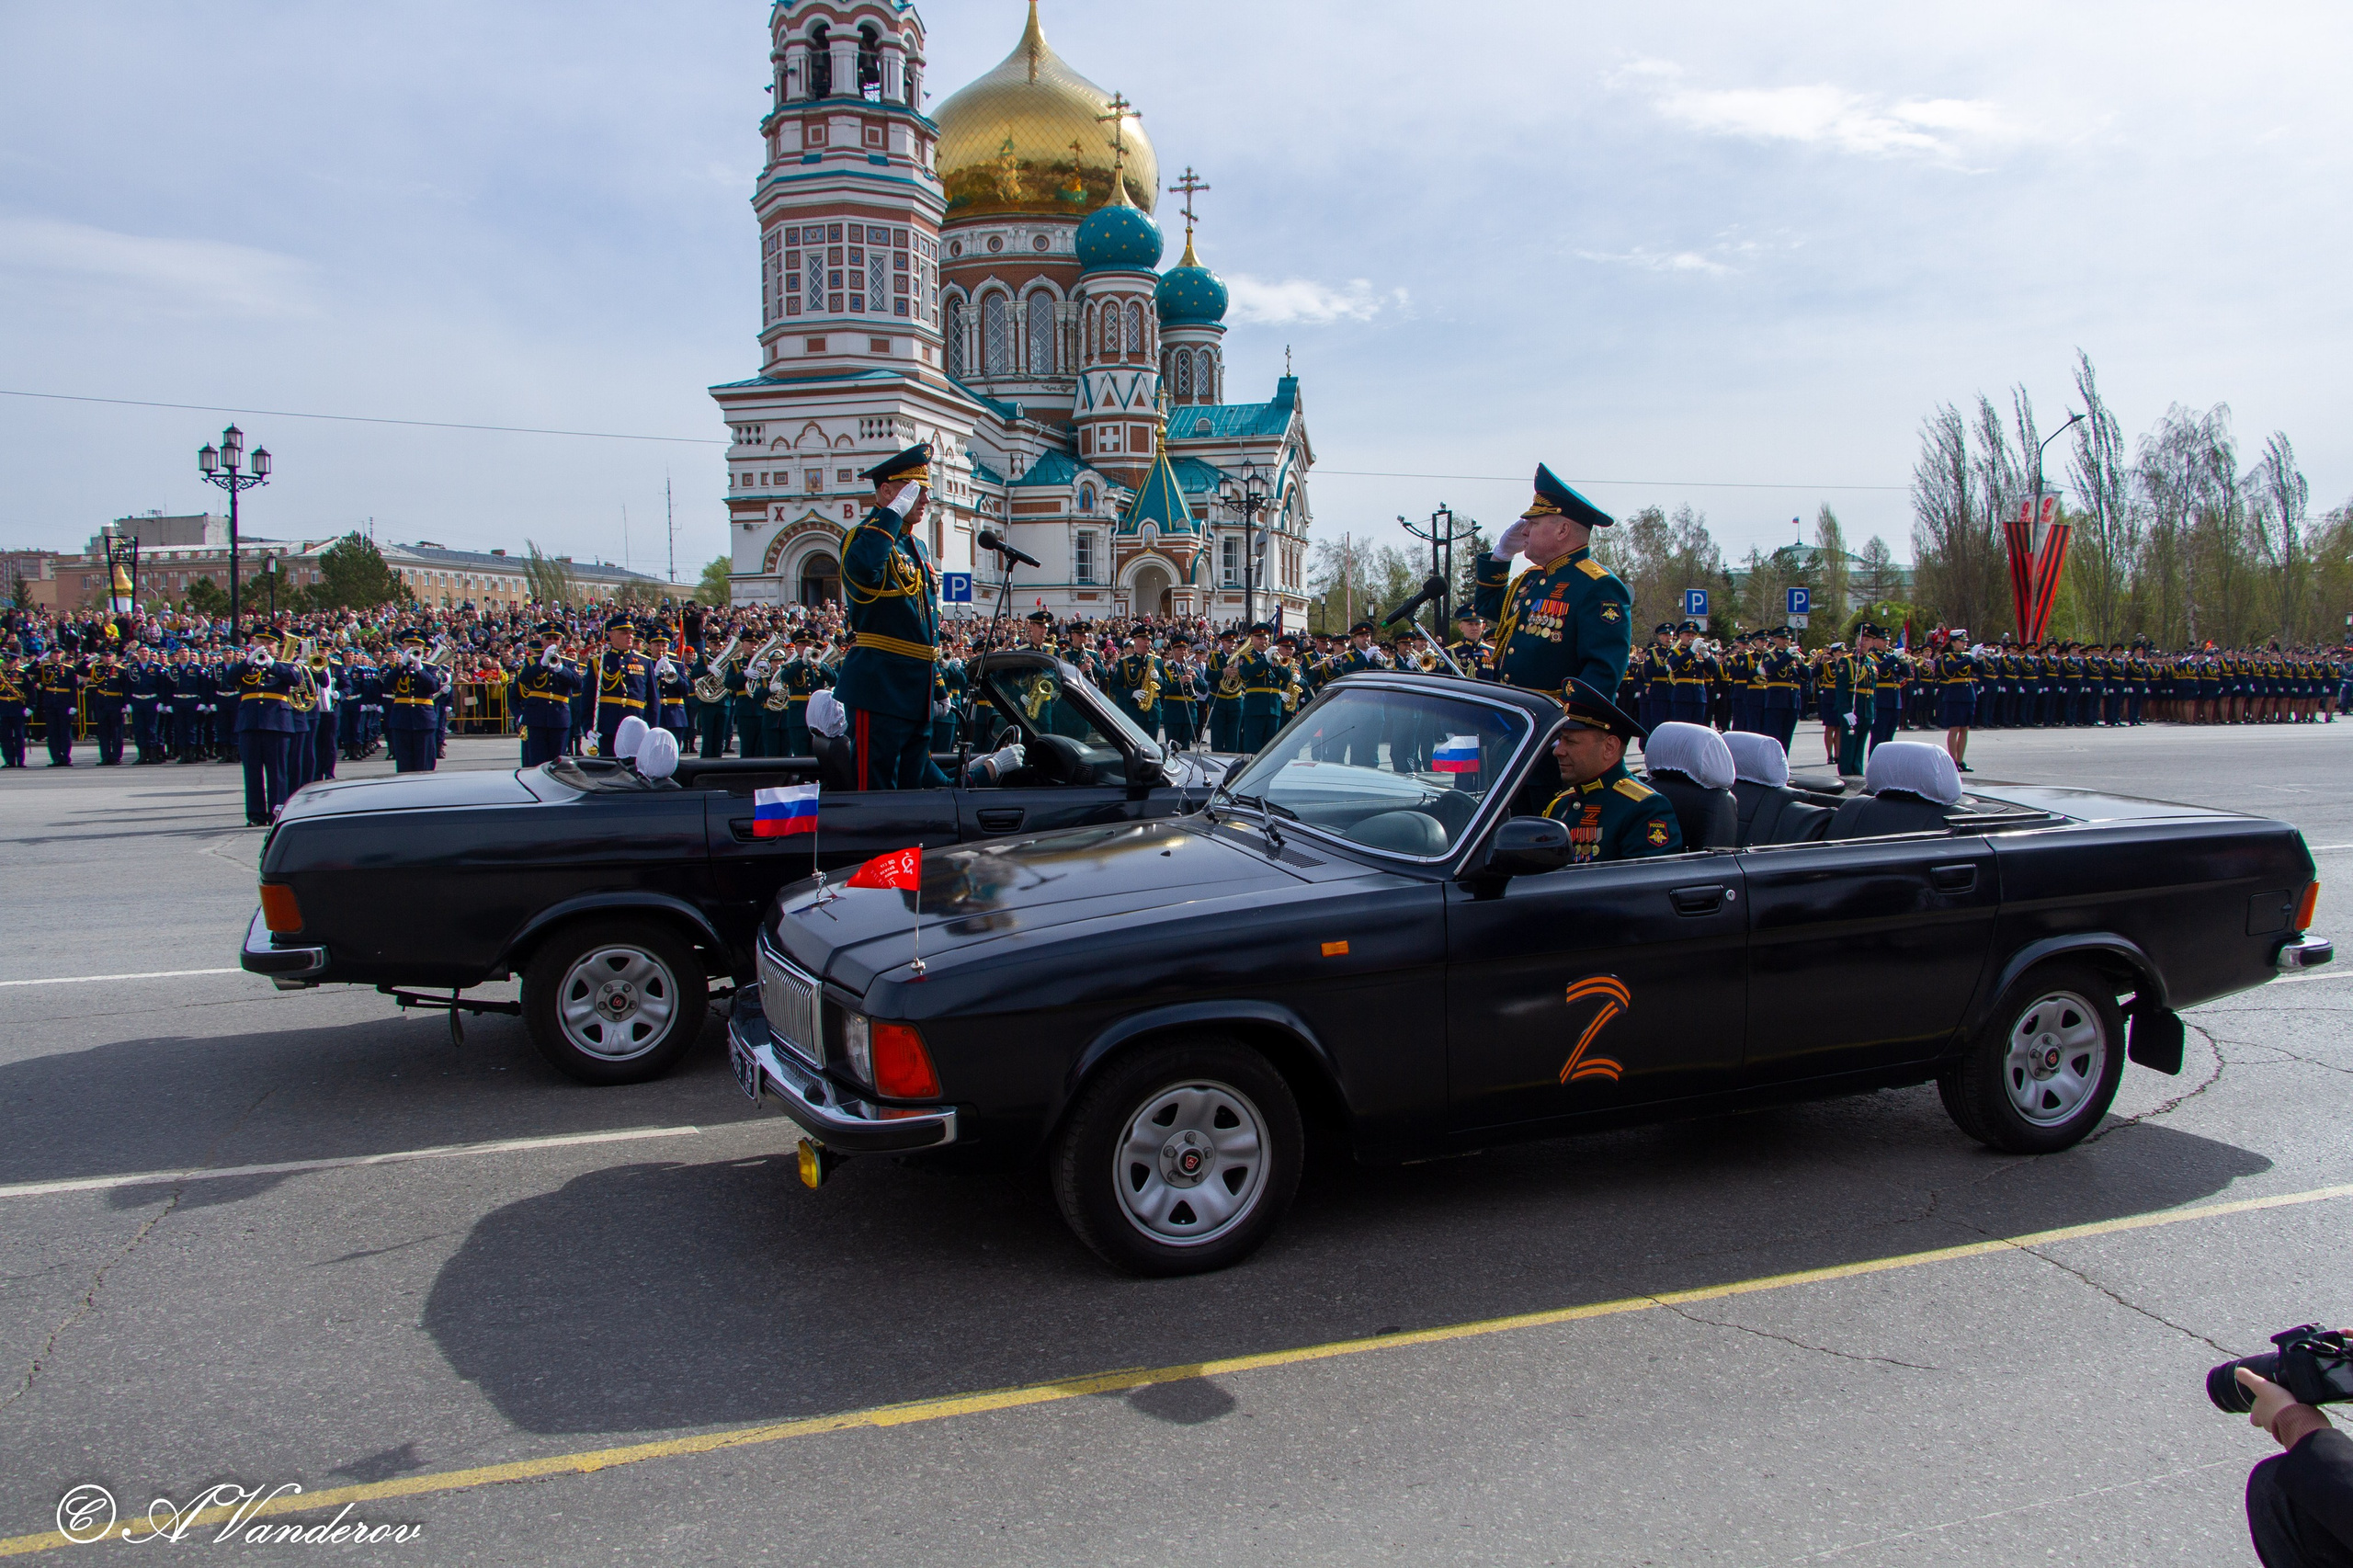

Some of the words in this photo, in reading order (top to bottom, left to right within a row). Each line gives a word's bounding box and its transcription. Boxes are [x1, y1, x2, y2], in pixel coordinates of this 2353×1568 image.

[2020, 501, 2030, 517] 9
[2042, 497, 2053, 514] 9
[951, 576, 968, 599] P
[1692, 593, 1704, 613] P
[1793, 591, 1806, 611] P
